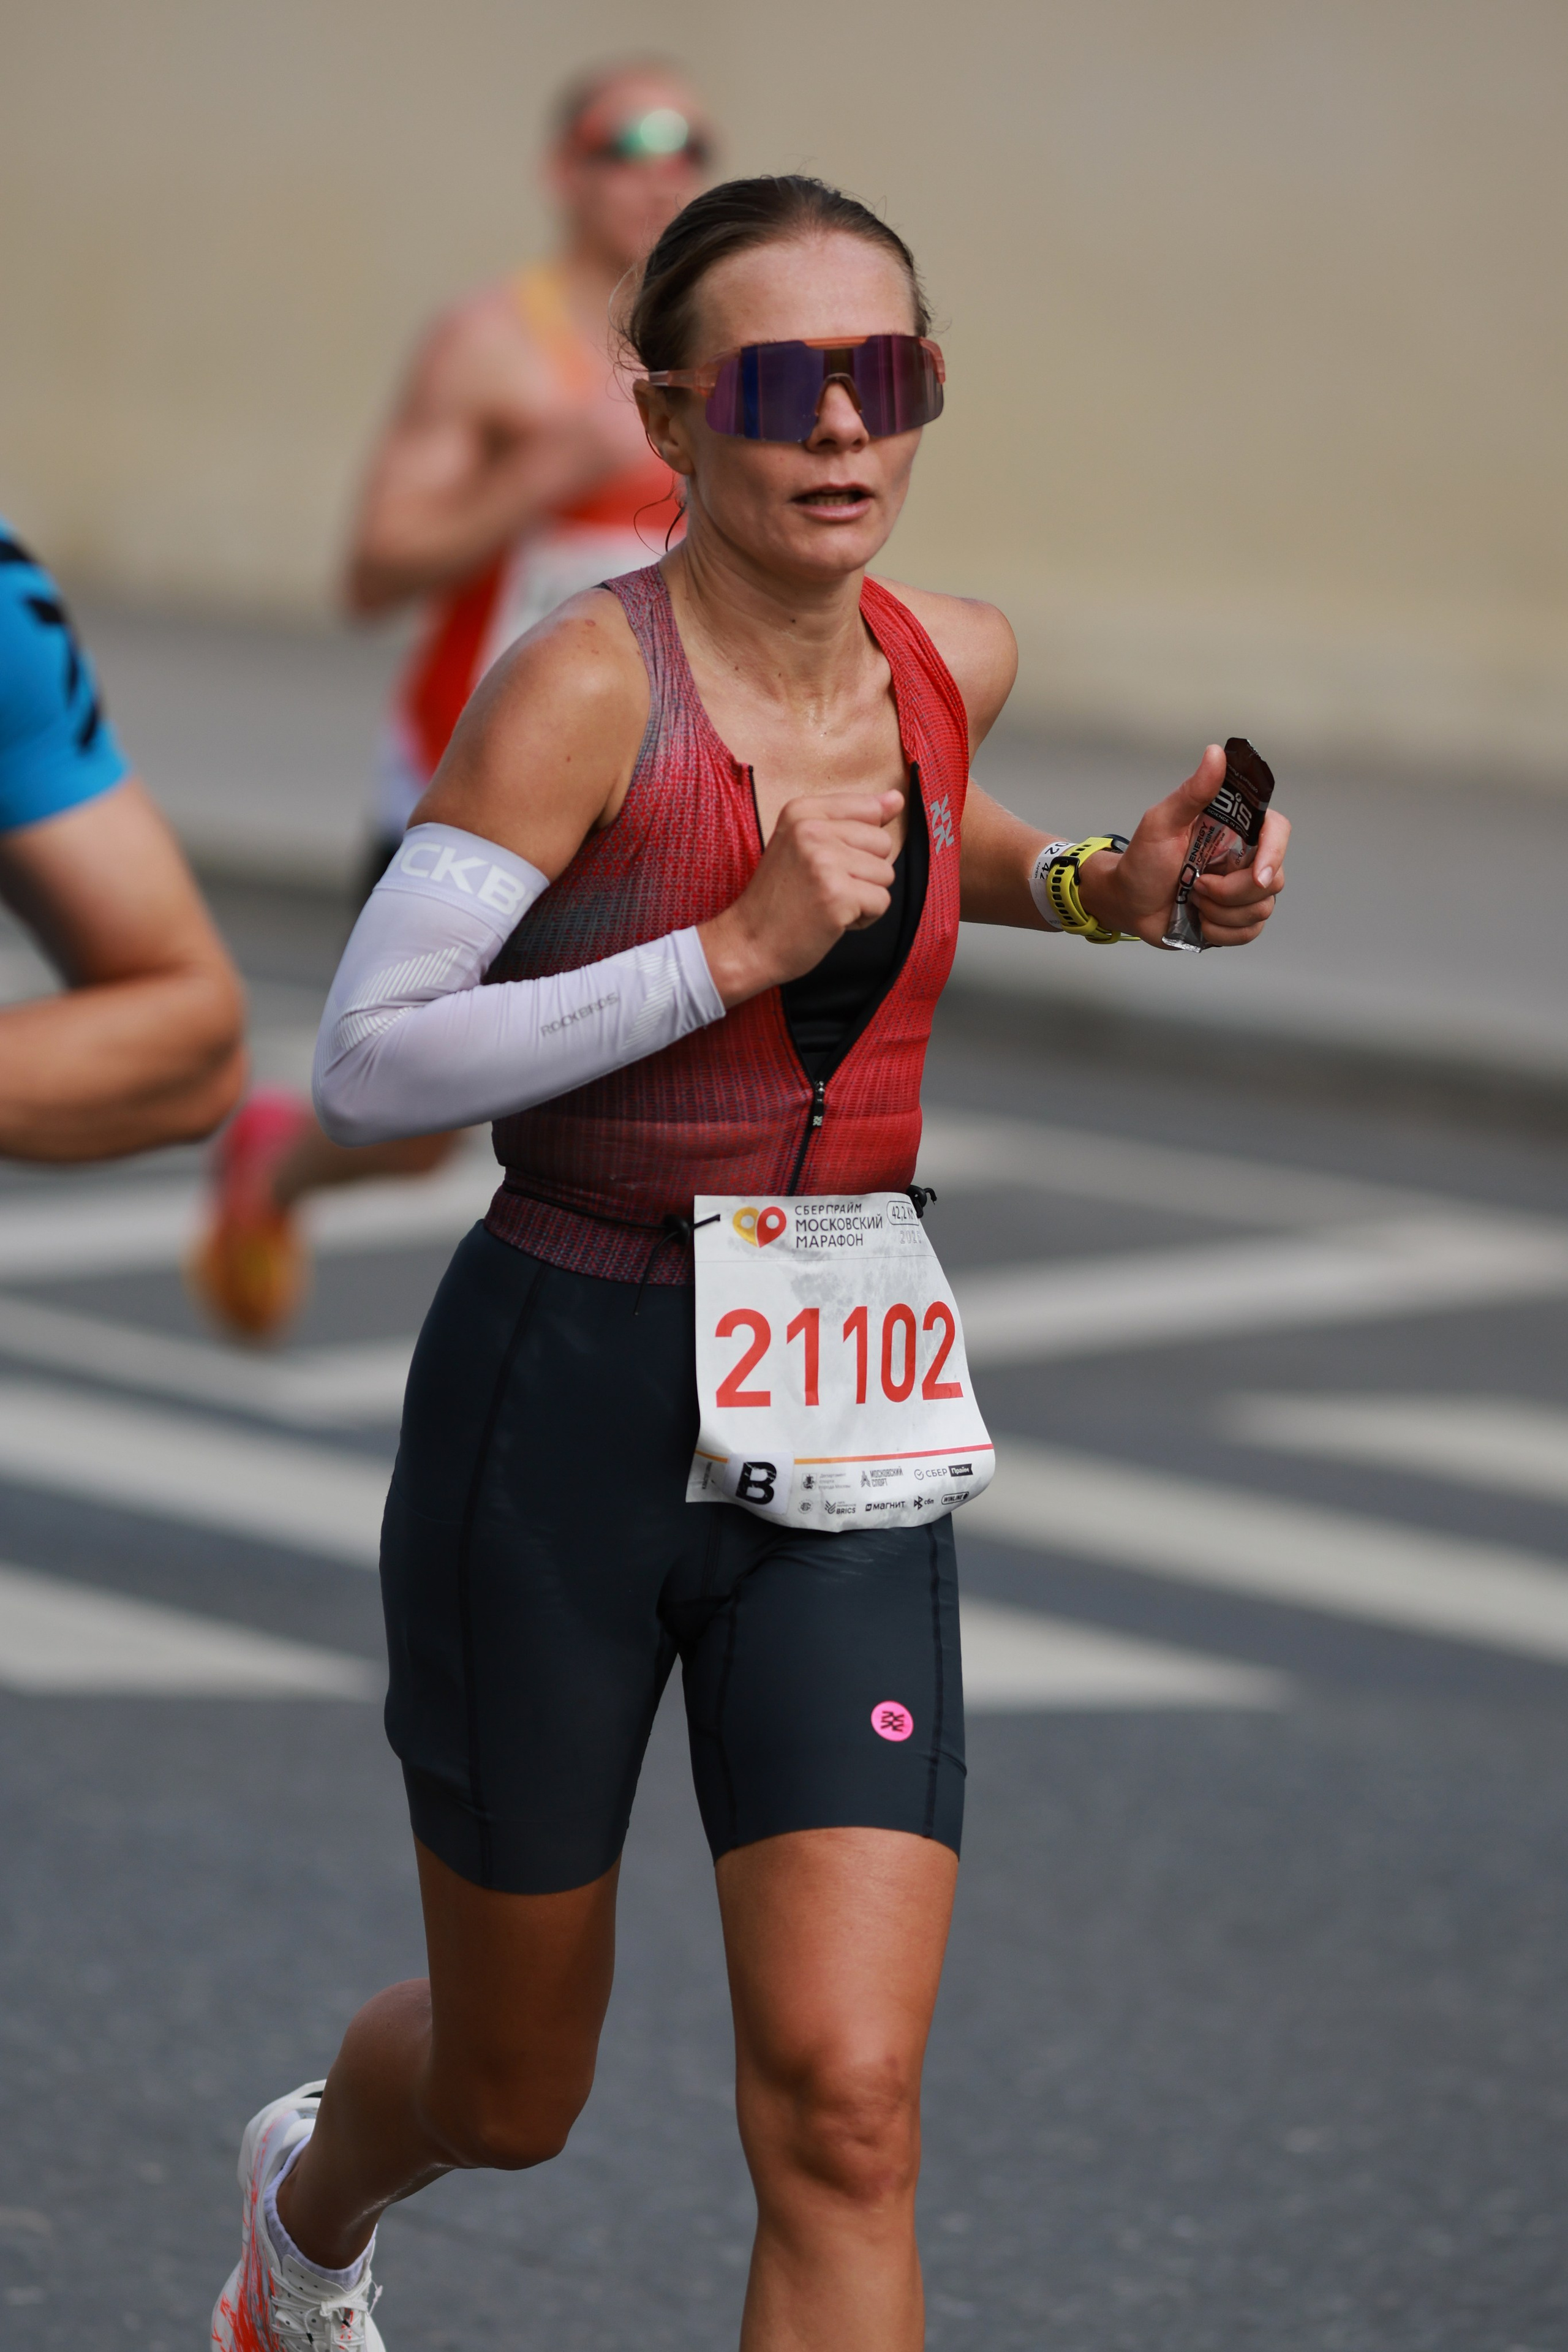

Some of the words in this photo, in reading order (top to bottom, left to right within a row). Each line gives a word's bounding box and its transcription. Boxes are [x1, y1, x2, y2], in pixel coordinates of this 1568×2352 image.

[1207, 809, 1229, 824] SCIENCE
[1188, 821, 1207, 863] ENERGY
[794, 1202, 862, 1215] СБЕРПРАЙМ
[892, 1205, 907, 1221] 42,2
[796, 1214, 883, 1232] МОСКОВСКИЙ
[796, 1234, 864, 1248] МАРАФОН
[714, 1300, 964, 1408] 21102
[870, 1466, 903, 1478] МОСКОВСКИЙ
[925, 1468, 948, 1477] СБЕР
[951, 1466, 970, 1475] Прайм
[736, 1461, 777, 1505] B
[872, 1478, 888, 1487] СПОРТ
[943, 1494, 964, 1502] WINLINE
